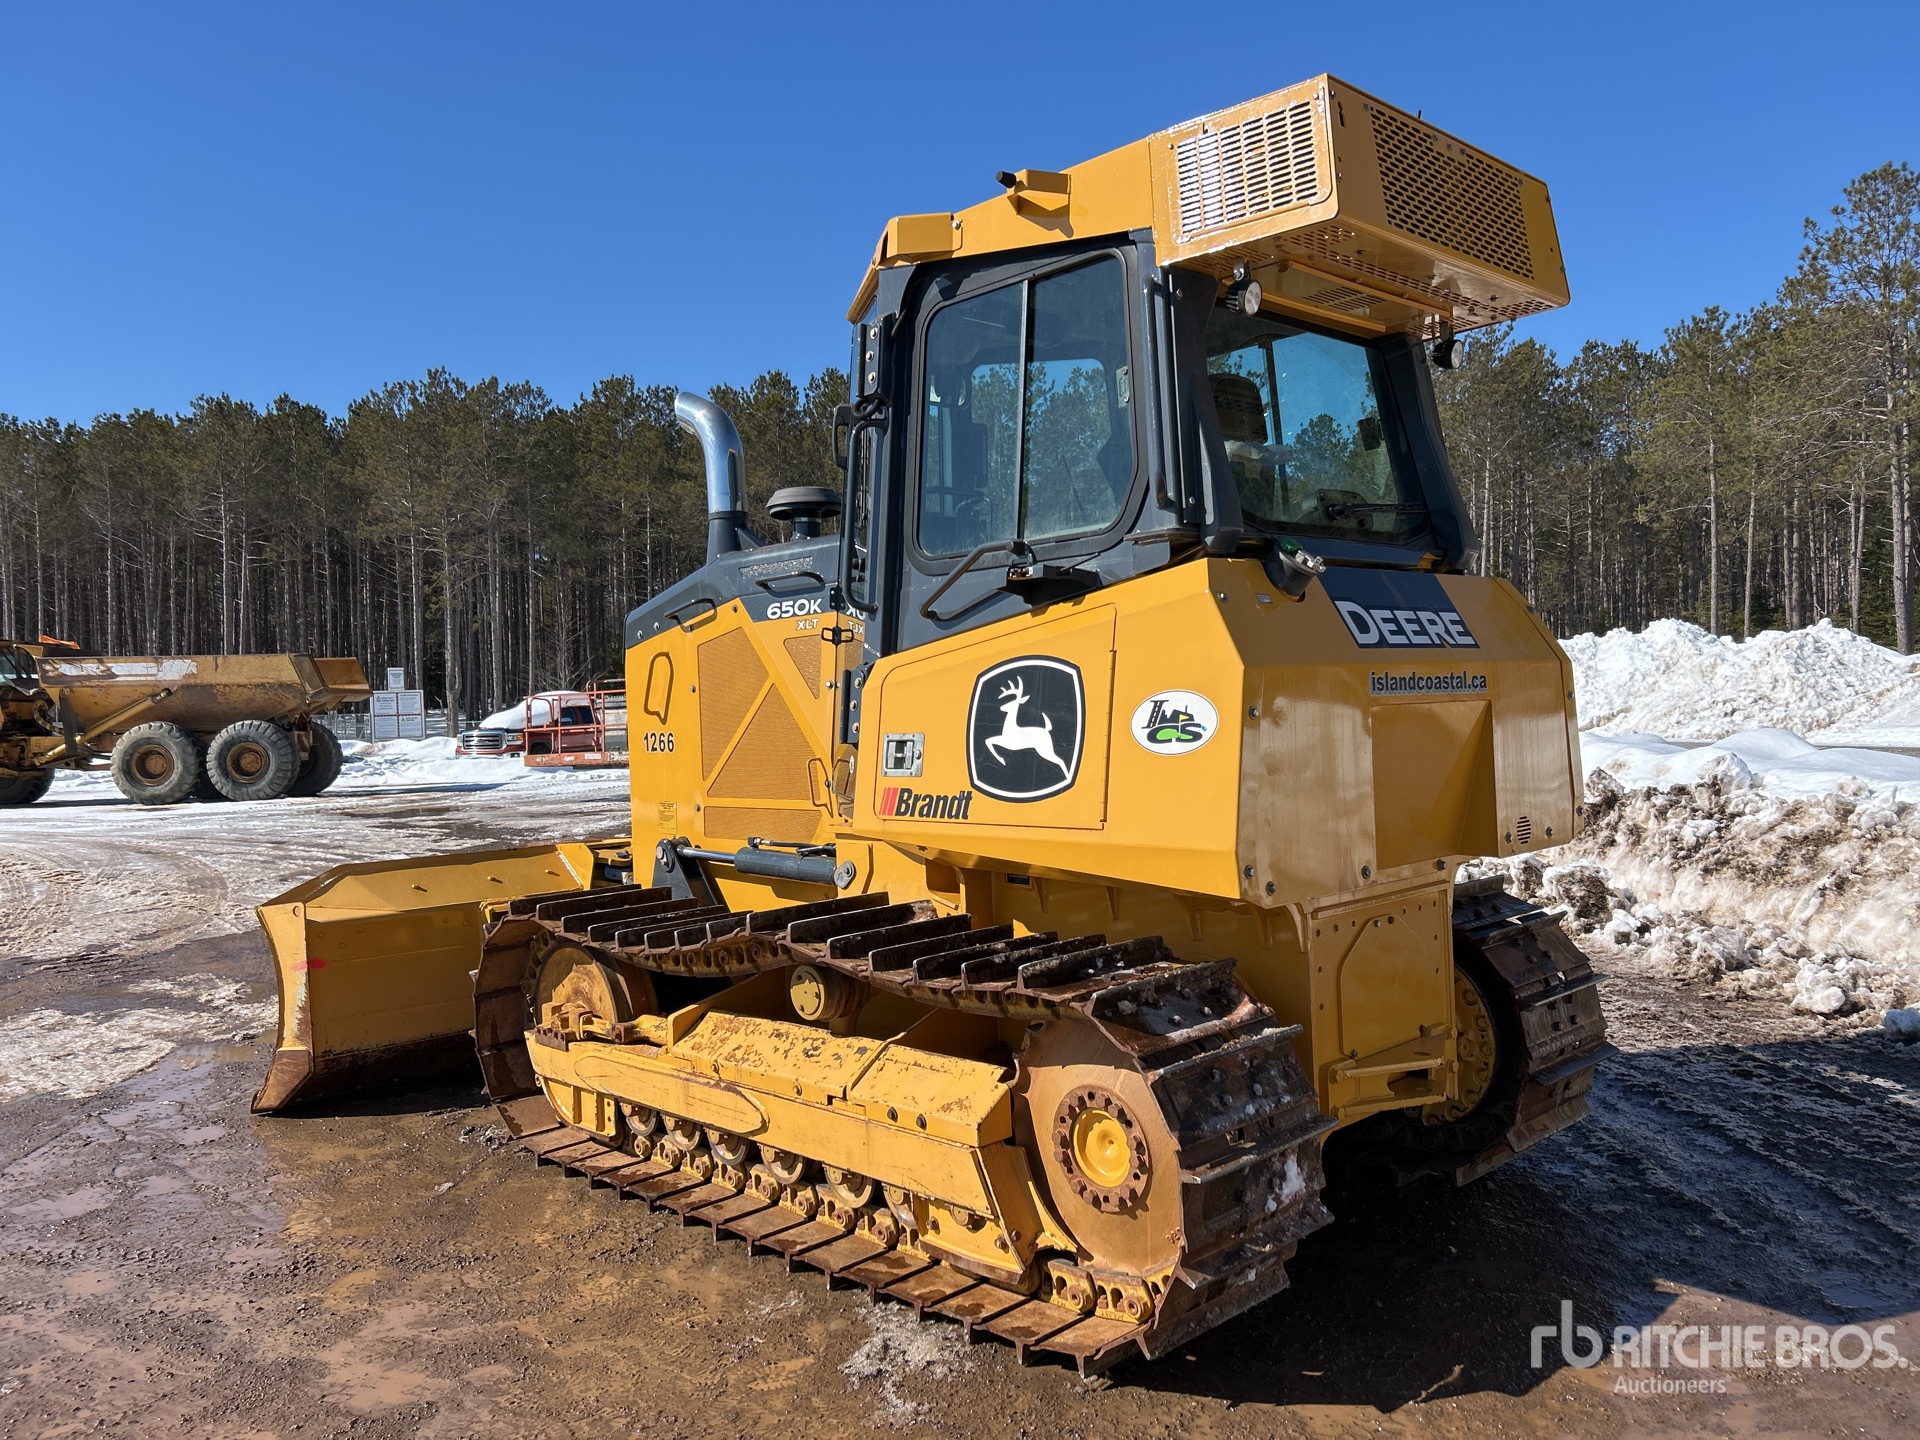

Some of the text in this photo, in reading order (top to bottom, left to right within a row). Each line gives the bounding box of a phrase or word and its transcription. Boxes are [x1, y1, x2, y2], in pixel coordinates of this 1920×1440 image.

[767, 599, 822, 620] 650K
[797, 619, 819, 631] XLT
[1335, 601, 1476, 644] DEERE
[1370, 671, 1487, 694] islandcoastal.ca
[643, 732, 675, 753] 1266
[895, 788, 973, 820] Brandt
